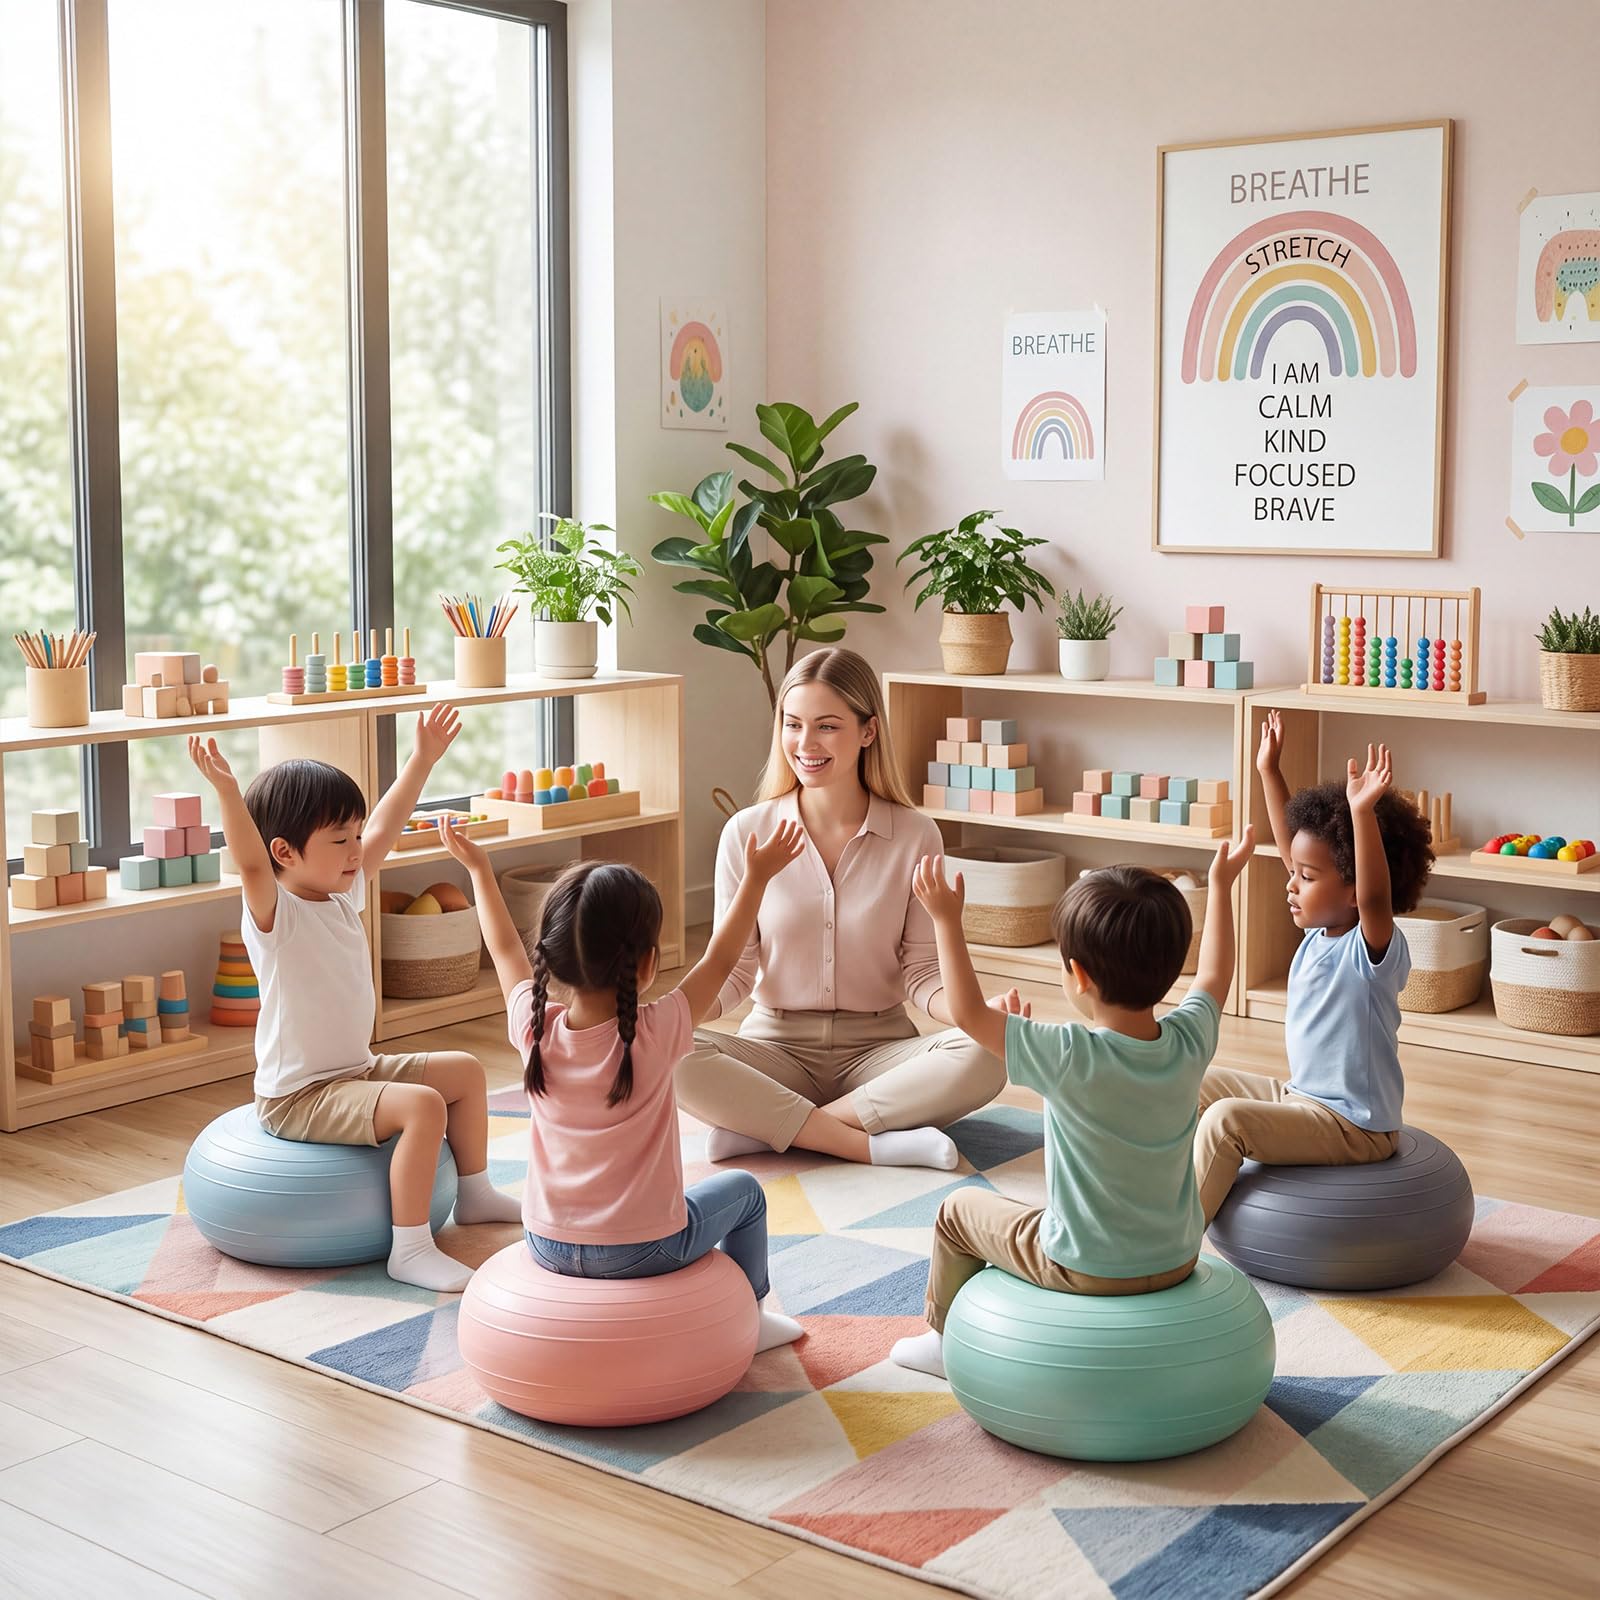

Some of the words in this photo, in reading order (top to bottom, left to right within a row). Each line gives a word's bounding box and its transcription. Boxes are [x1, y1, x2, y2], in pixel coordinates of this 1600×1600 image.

[1231, 163, 1369, 203] BREATHE
[1246, 237, 1351, 274] STRETCH
[1013, 333, 1094, 355] BREATHE
[1284, 363, 1318, 384] AM
[1259, 395, 1331, 418] CALM
[1266, 430, 1325, 452] KIND
[1236, 464, 1355, 486] FOCUSED
[1255, 498, 1334, 521] BRAVE
